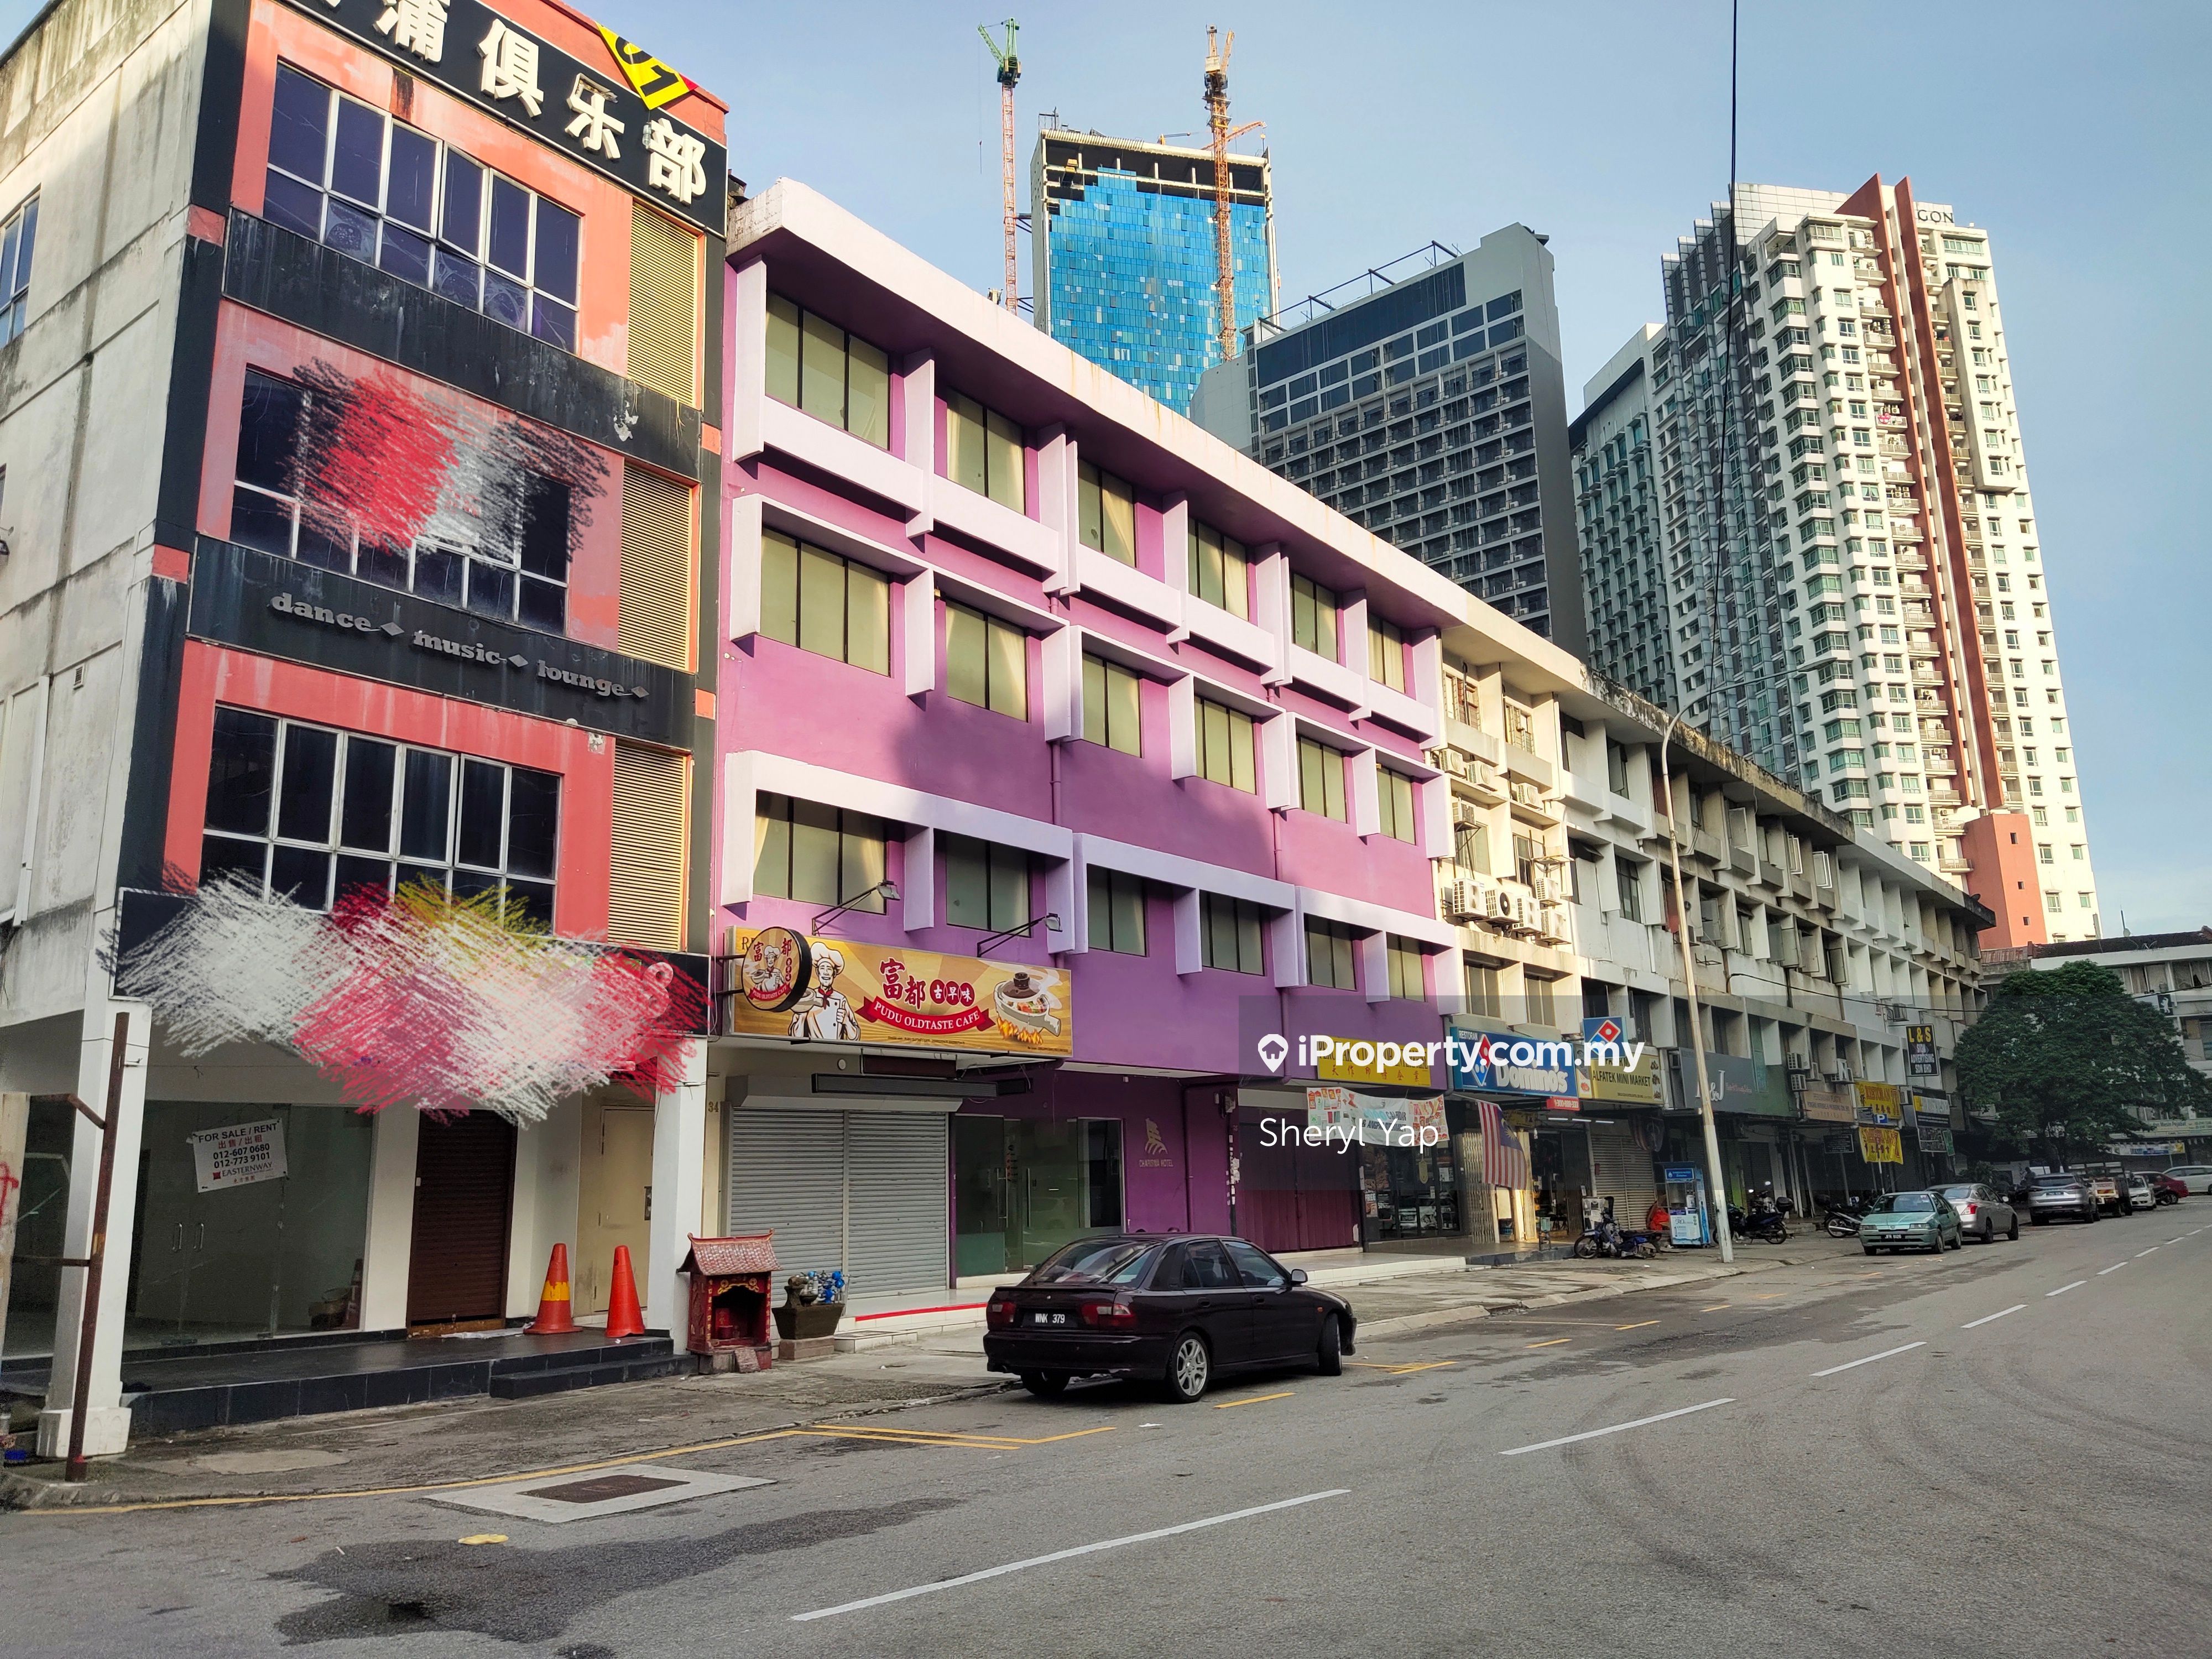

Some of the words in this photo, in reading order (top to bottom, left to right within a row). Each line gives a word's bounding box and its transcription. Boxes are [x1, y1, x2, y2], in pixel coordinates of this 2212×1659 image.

[270, 593, 372, 632] dance
[413, 630, 502, 665] music
[537, 659, 625, 697] lounge
[880, 957, 926, 1010] 富都
[932, 982, 974, 1005] 古早味
[874, 1001, 902, 1023] PUDU
[904, 1016, 954, 1030] OLDTASTE
[956, 1010, 980, 1027] CAFE
[1908, 1027, 1914, 1043] L
[1916, 1027, 1923, 1043] &
[1924, 1026, 1932, 1043] S
[1911, 1053, 1935, 1063] ADVERTISING
[1915, 1063, 1923, 1074] SDN
[1923, 1063, 1932, 1074] BHD
[1593, 1070, 1616, 1083] ALFATEK
[1616, 1074, 1629, 1084] MINI
[1629, 1075, 1651, 1087] MARKET
[708, 1101, 719, 1113] 34
[1877, 1114, 1886, 1124] P
[198, 1134, 219, 1143] FOR
[222, 1129, 247, 1139] SALE
[254, 1123, 276, 1133] RENT
[213, 1147, 248, 1160] 012-607
[250, 1143, 270, 1154] 0680
[214, 1155, 248, 1168] 012-773
[250, 1152, 270, 1162] 9101
[1139, 1159, 1160, 1167] CHARISMA
[1160, 1159, 1173, 1167] HOTEL
[222, 1162, 273, 1177] EASTERNWAY
[1035, 1313, 1048, 1323] WNK
[1052, 1313, 1065, 1324] 379
